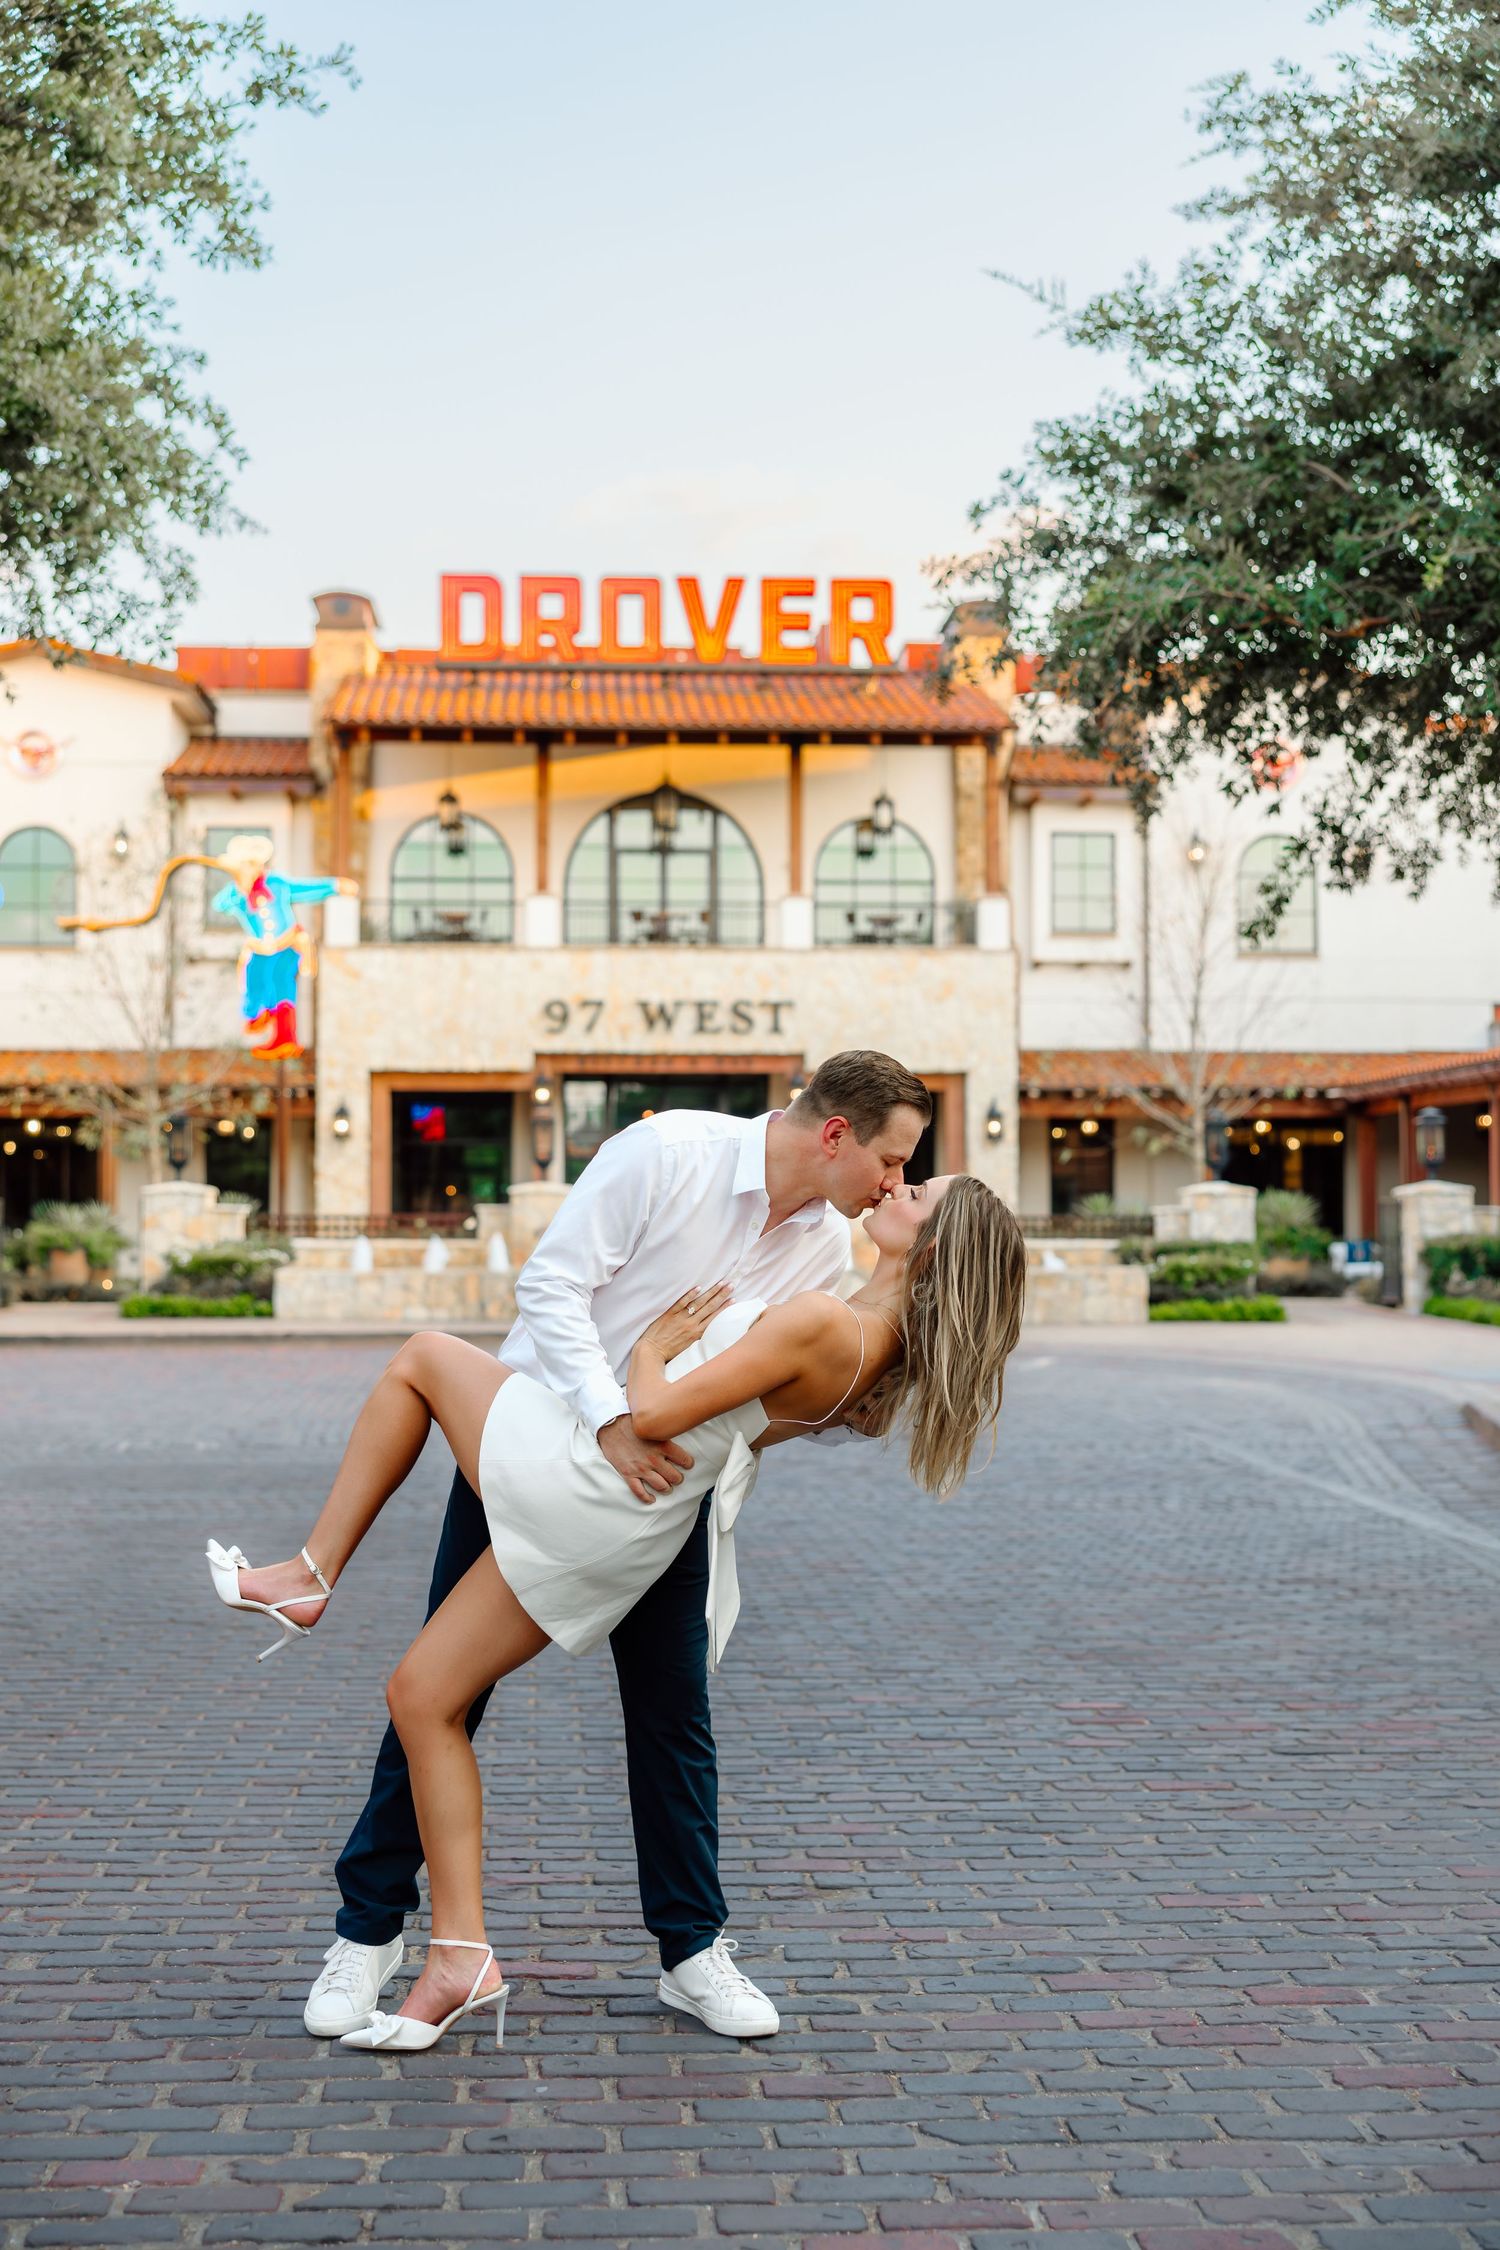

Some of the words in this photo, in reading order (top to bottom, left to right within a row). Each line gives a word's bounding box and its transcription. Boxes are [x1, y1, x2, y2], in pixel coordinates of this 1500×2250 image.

[439, 574, 895, 667] DROVER
[543, 999, 604, 1035] 97
[636, 999, 795, 1035] WEST
